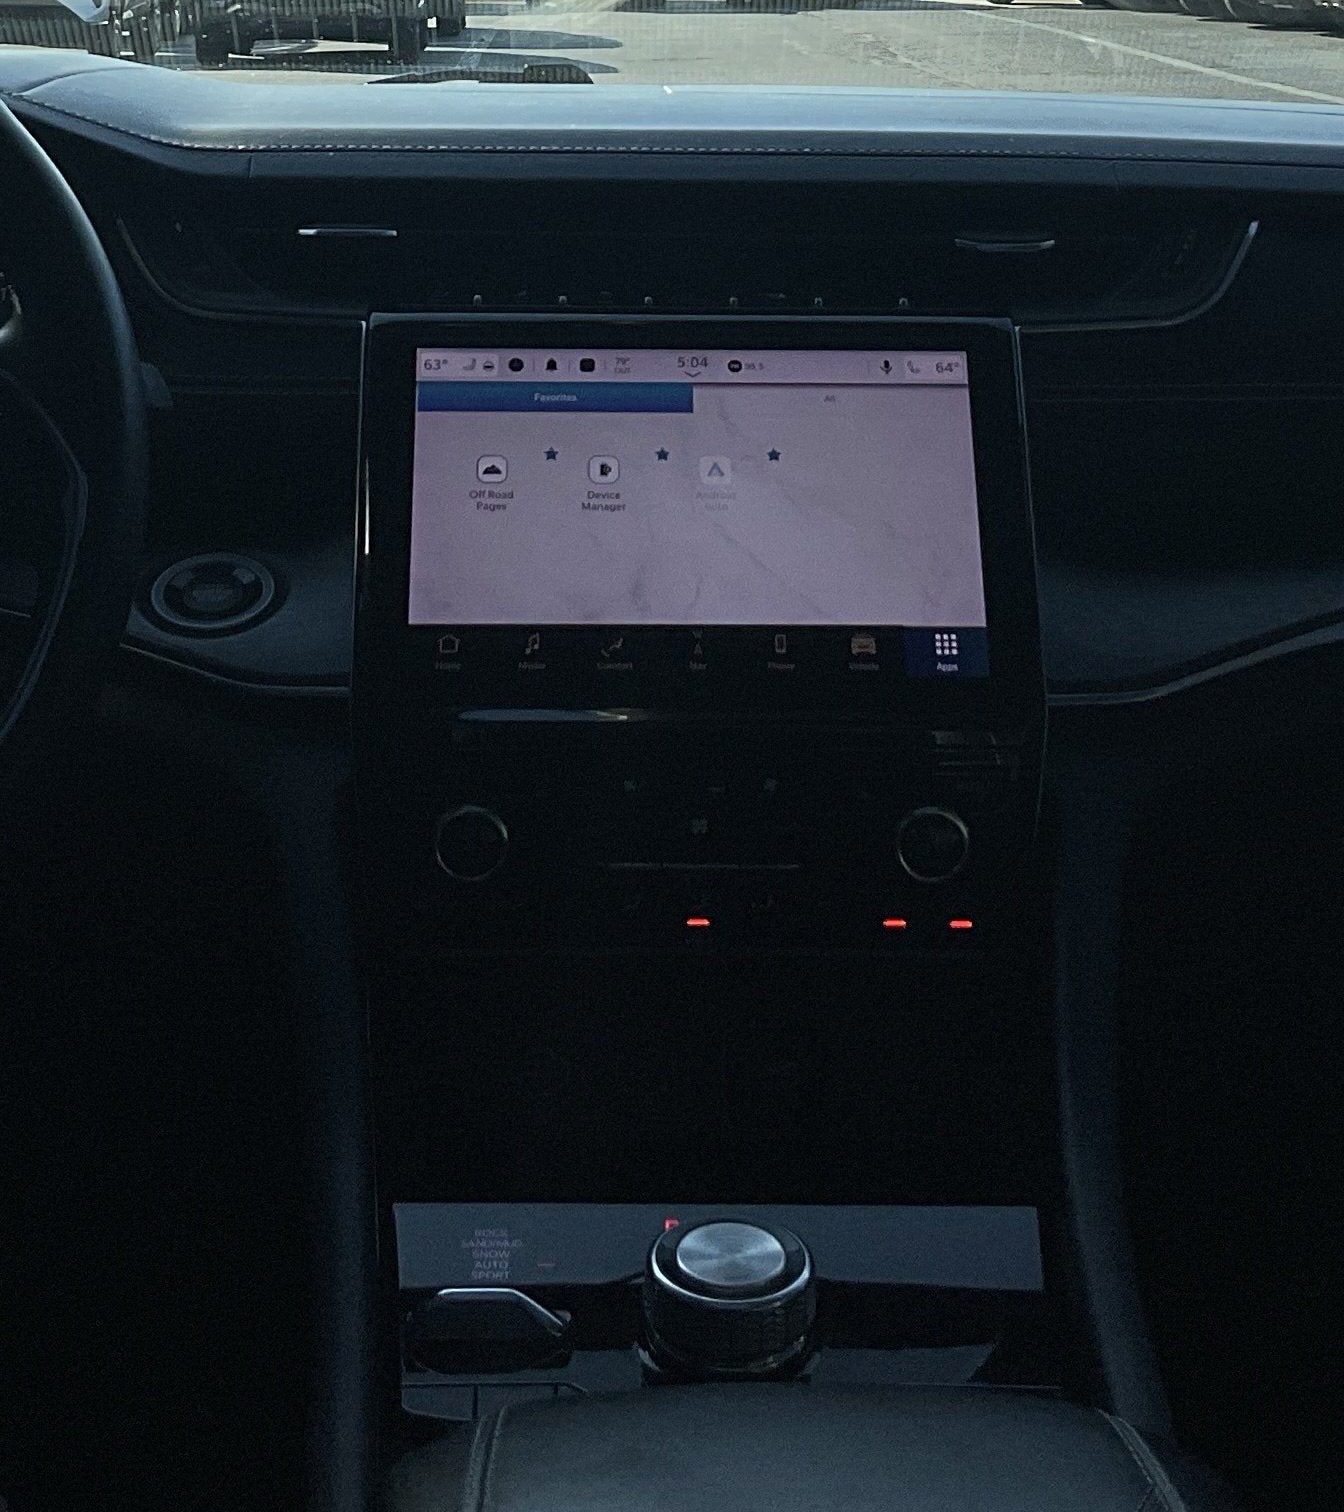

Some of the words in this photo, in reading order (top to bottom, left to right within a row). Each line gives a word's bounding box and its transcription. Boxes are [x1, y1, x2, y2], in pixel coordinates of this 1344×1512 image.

[676, 356, 709, 369] 5:04
[534, 392, 577, 402] Favorites
[468, 489, 486, 500] Off
[488, 489, 514, 500] Road
[587, 489, 621, 500] Device
[476, 501, 507, 512] Pages
[581, 501, 627, 513] Manager
[936, 662, 959, 672] Apps
[472, 1250, 511, 1259] SNOW
[474, 1260, 509, 1270] AUTO
[471, 1271, 510, 1280] SPORT
